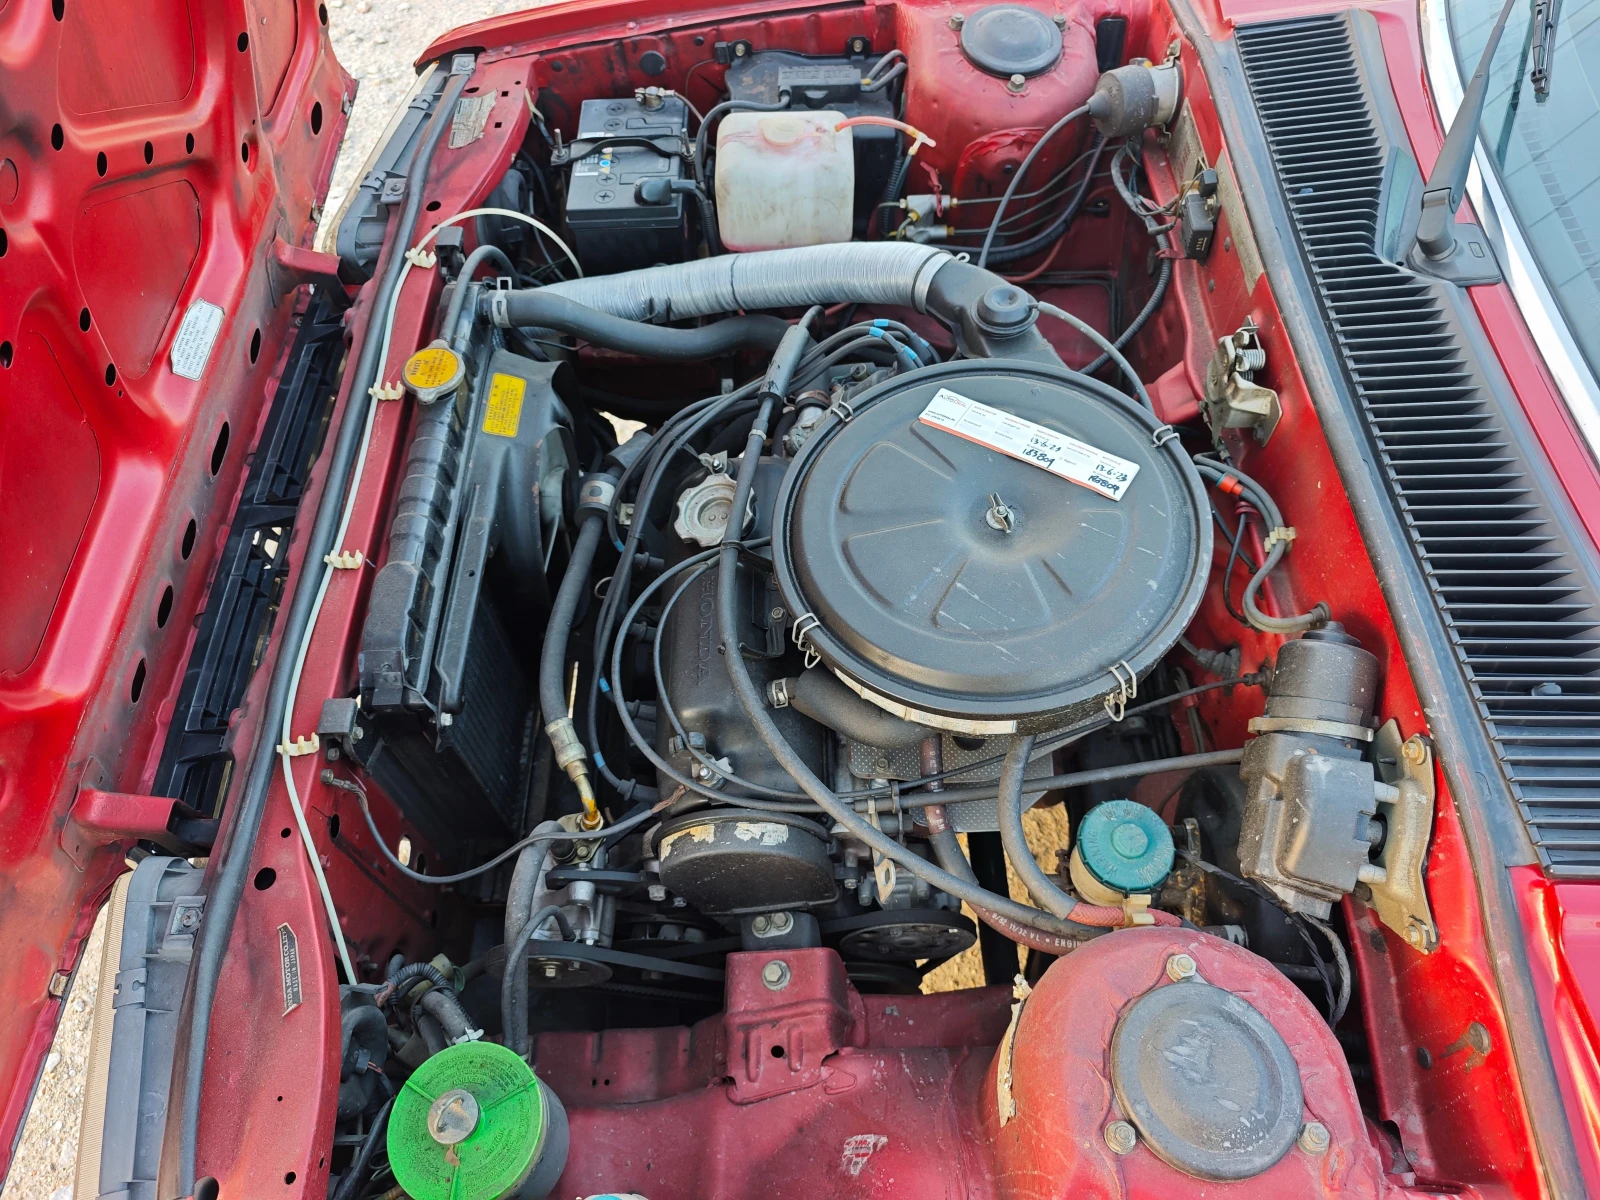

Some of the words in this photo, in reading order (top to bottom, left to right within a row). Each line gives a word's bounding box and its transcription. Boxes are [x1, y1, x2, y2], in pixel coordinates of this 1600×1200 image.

[696, 575, 715, 686] HONDA
[1087, 830, 1119, 879] WARNING
[284, 956, 292, 986] MOTOR
